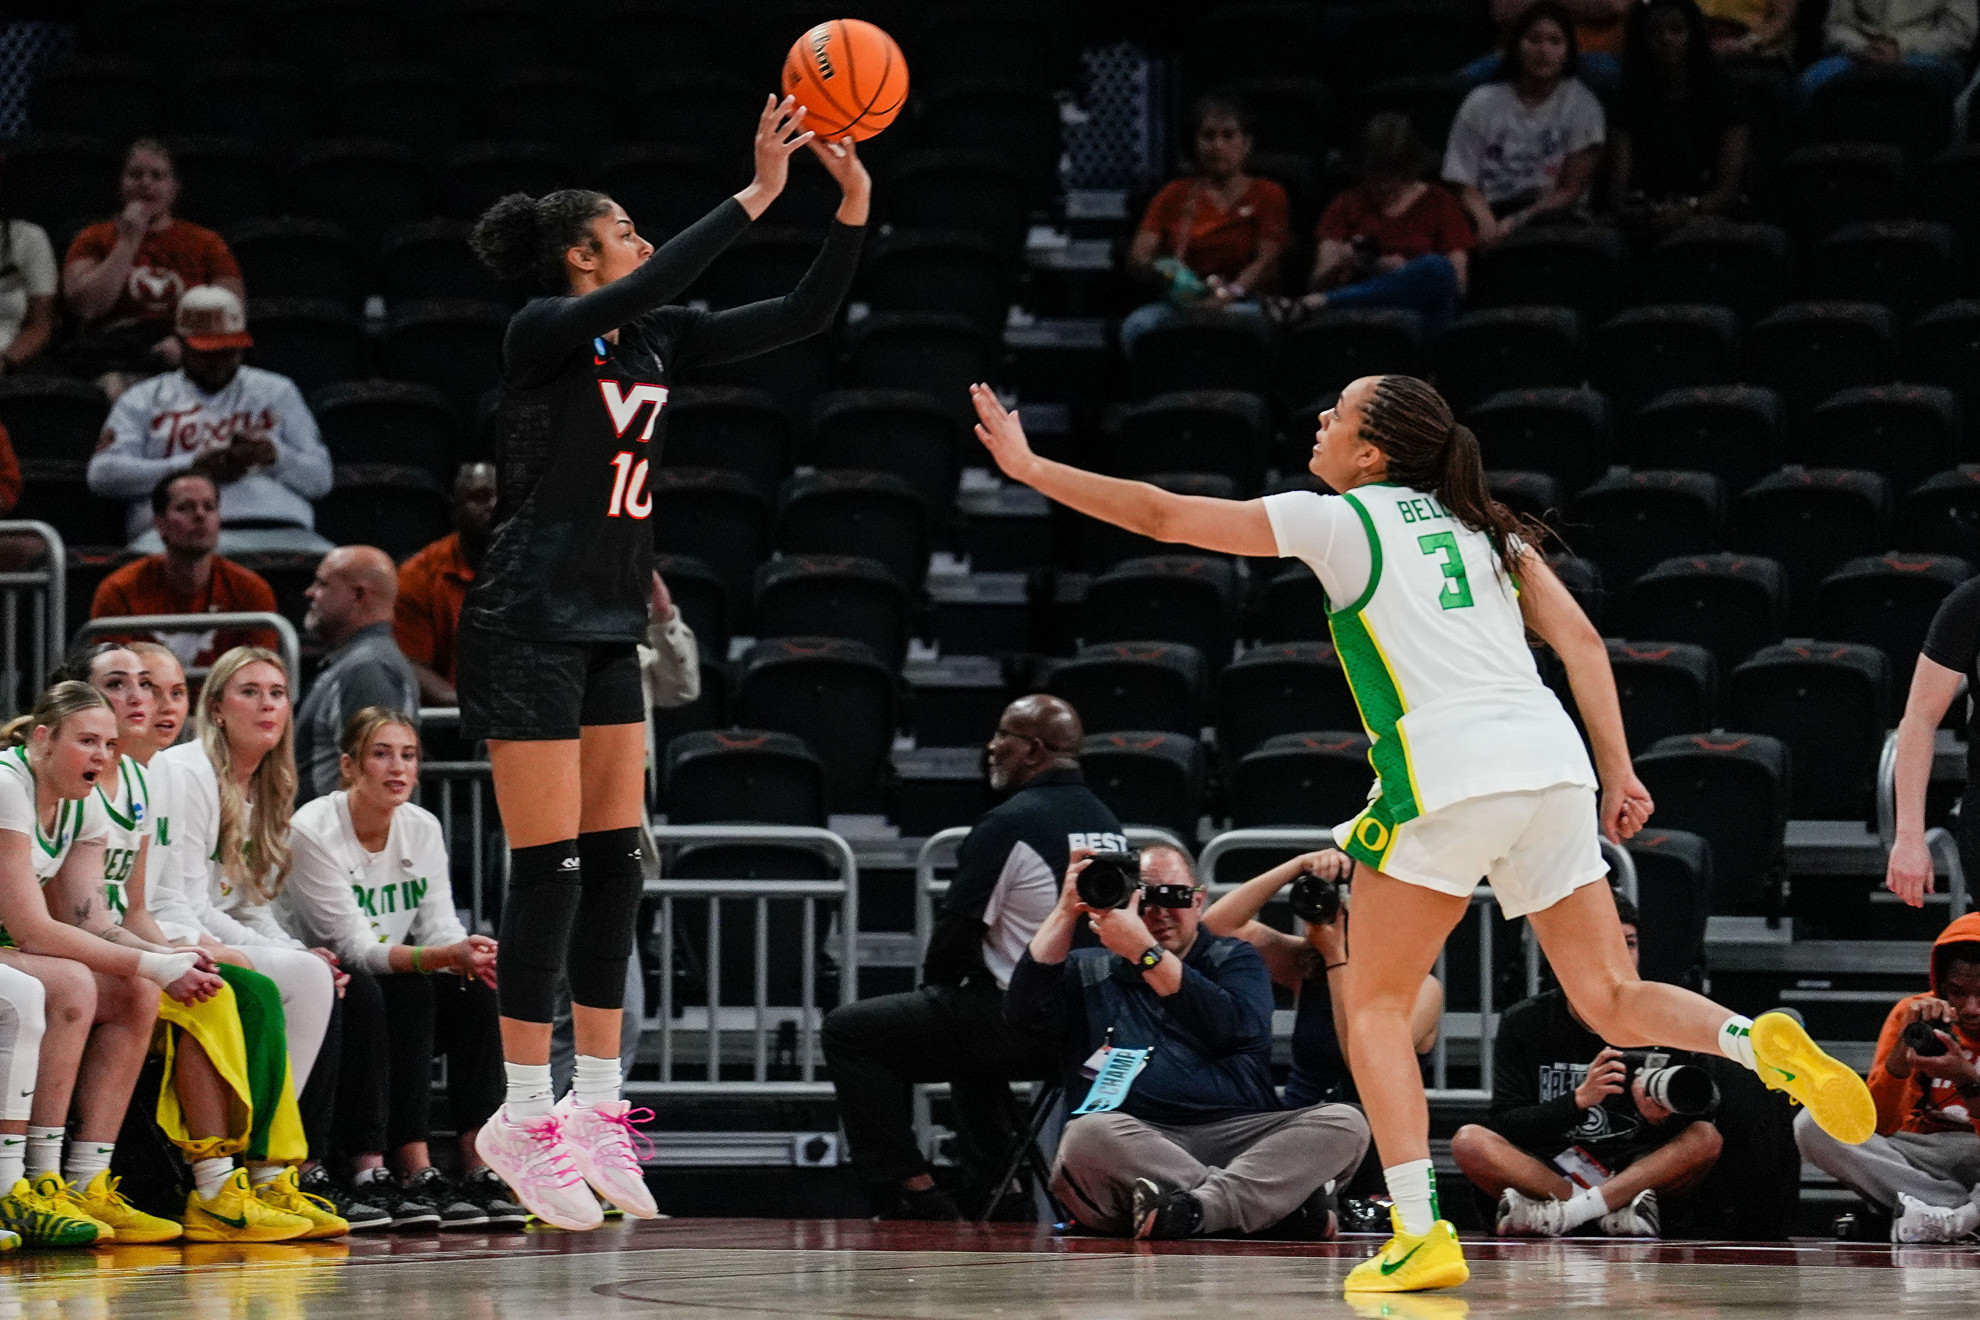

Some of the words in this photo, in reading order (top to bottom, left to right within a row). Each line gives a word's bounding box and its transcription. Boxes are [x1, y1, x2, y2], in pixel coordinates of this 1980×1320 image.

[152, 403, 276, 458] Texas
[597, 379, 669, 443] VT
[607, 451, 653, 520] 10
[1417, 530, 1474, 611] 3
[1067, 832, 1128, 853] BEST
